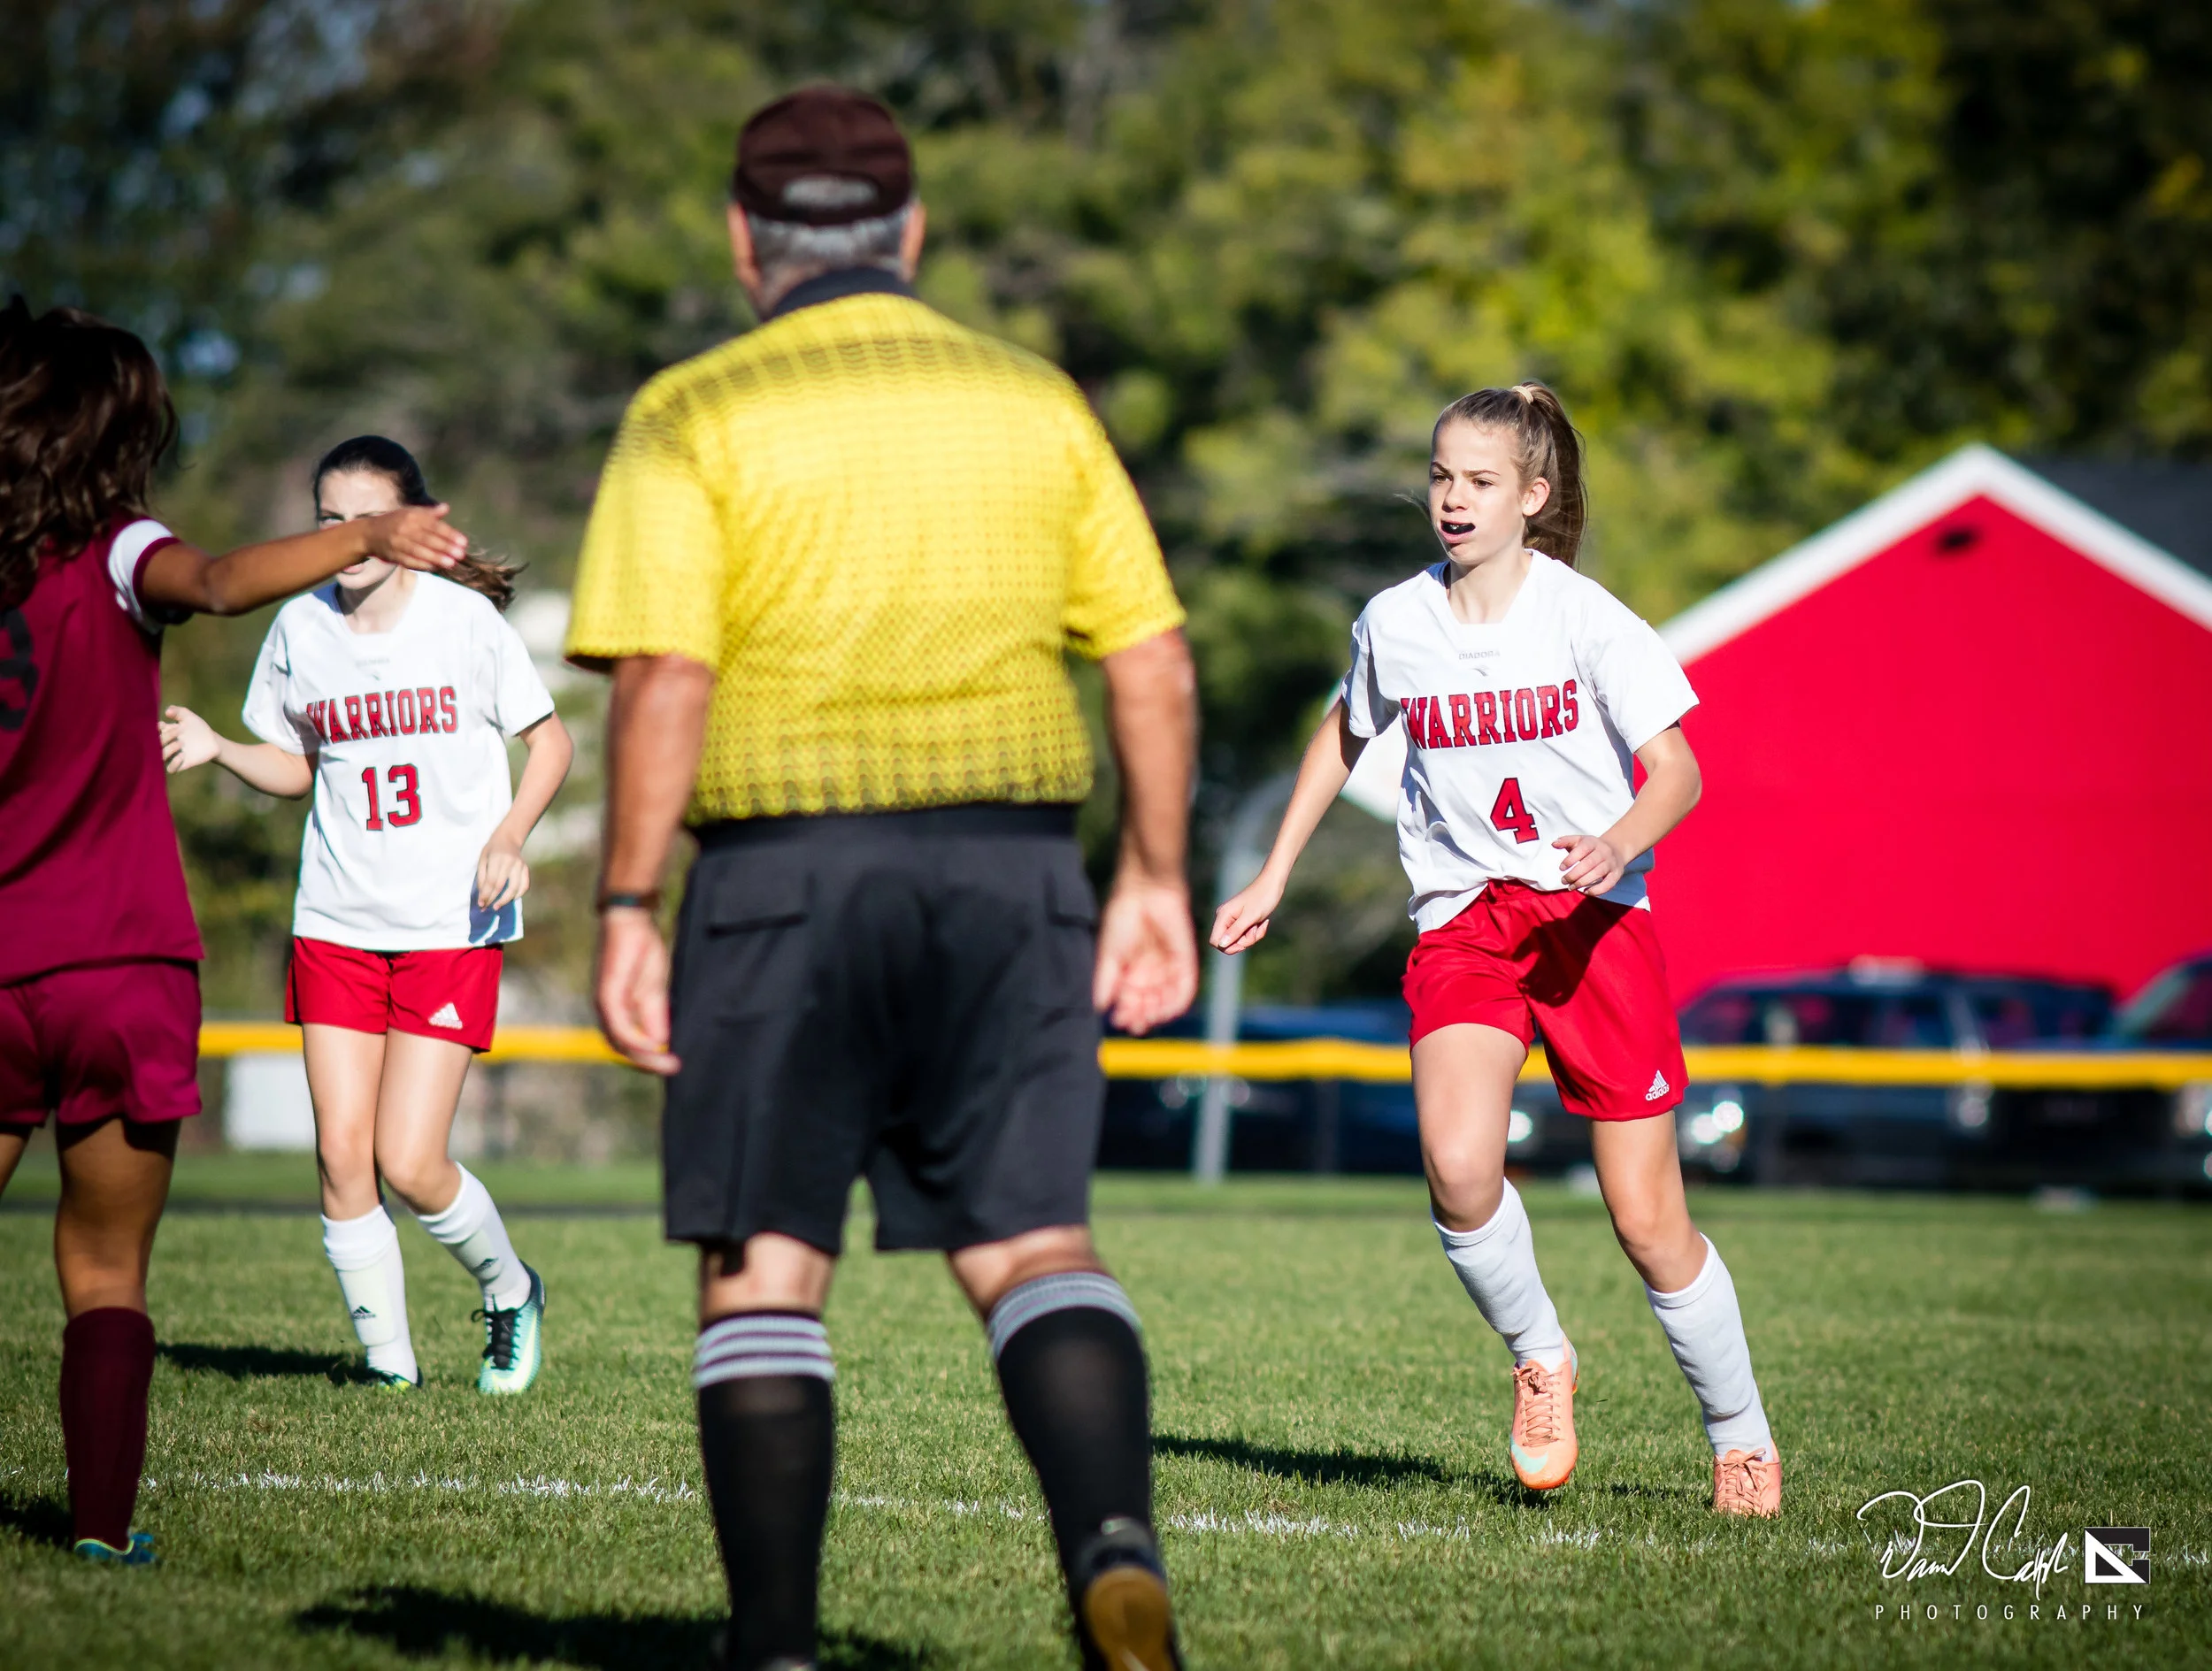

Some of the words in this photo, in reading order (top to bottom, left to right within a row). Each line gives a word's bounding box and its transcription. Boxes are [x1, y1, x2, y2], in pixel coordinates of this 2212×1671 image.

[306, 686, 458, 744] WARRIORS
[1401, 678, 1578, 749] WARRIORS
[361, 763, 422, 831] 13
[1490, 777, 1540, 844] 4
[1645, 1084, 1670, 1101] adidas
